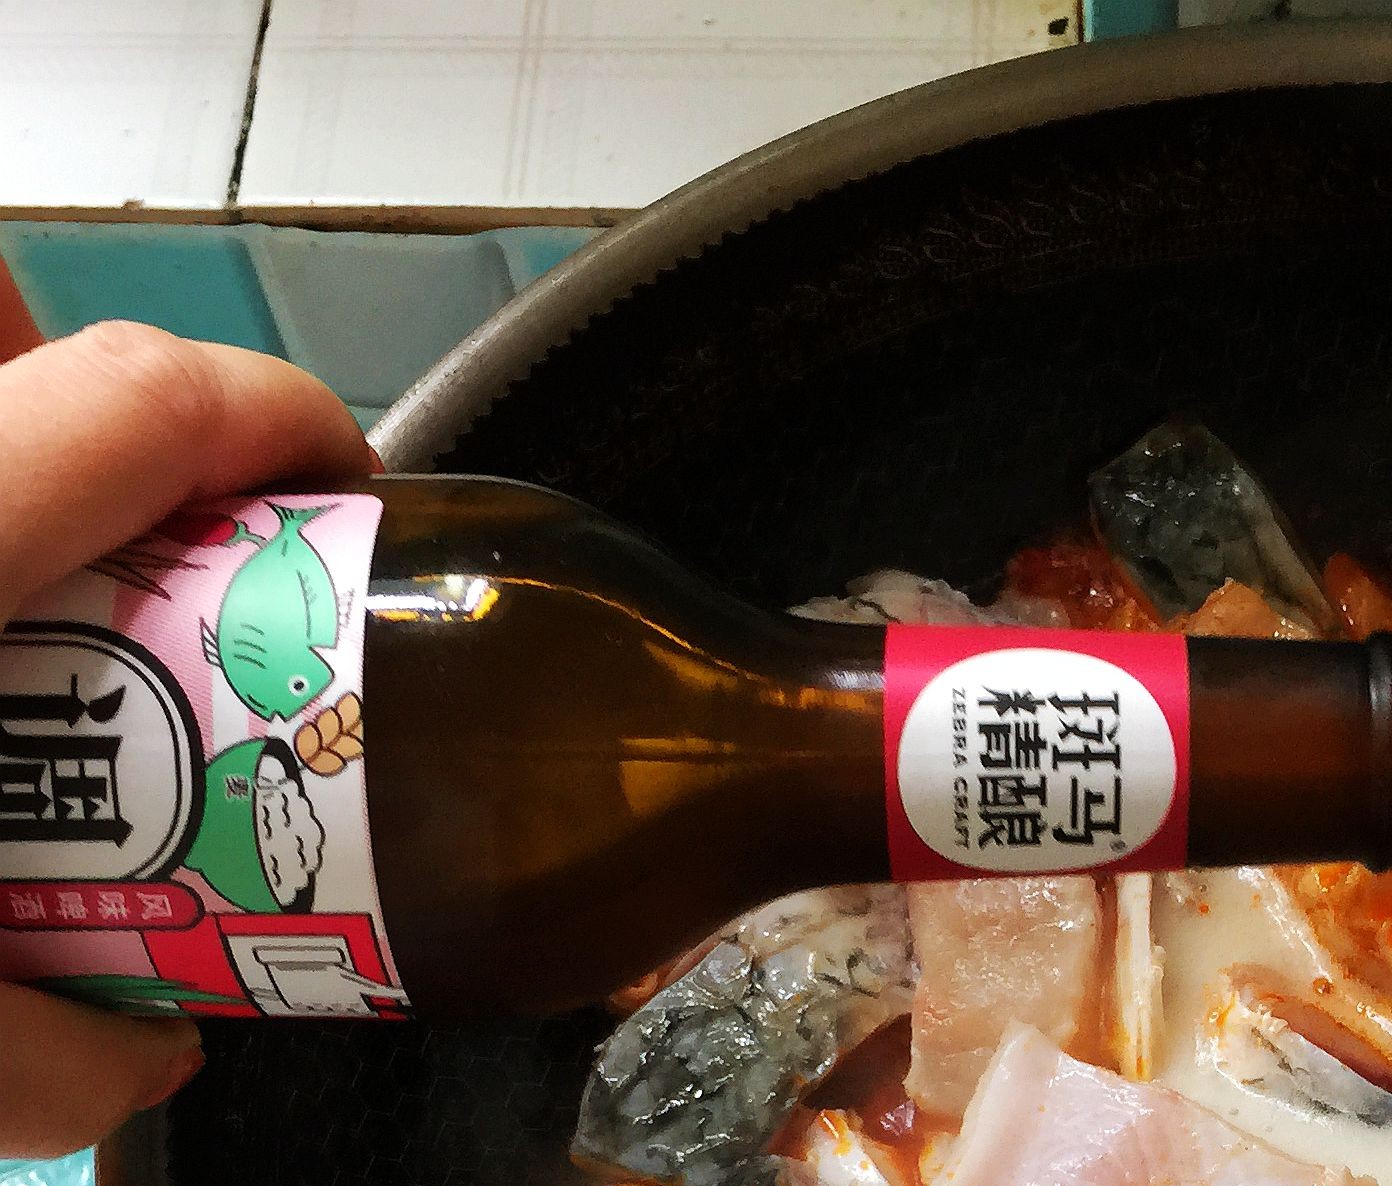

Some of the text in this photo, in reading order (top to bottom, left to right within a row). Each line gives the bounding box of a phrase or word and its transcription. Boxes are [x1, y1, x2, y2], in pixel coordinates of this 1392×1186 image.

[952, 688, 970, 850] ZEBRA CRAFT
[976, 686, 1048, 850] 精酿
[1048, 688, 1122, 846] 斑马
[9, 890, 173, 921] 风味啤酒
